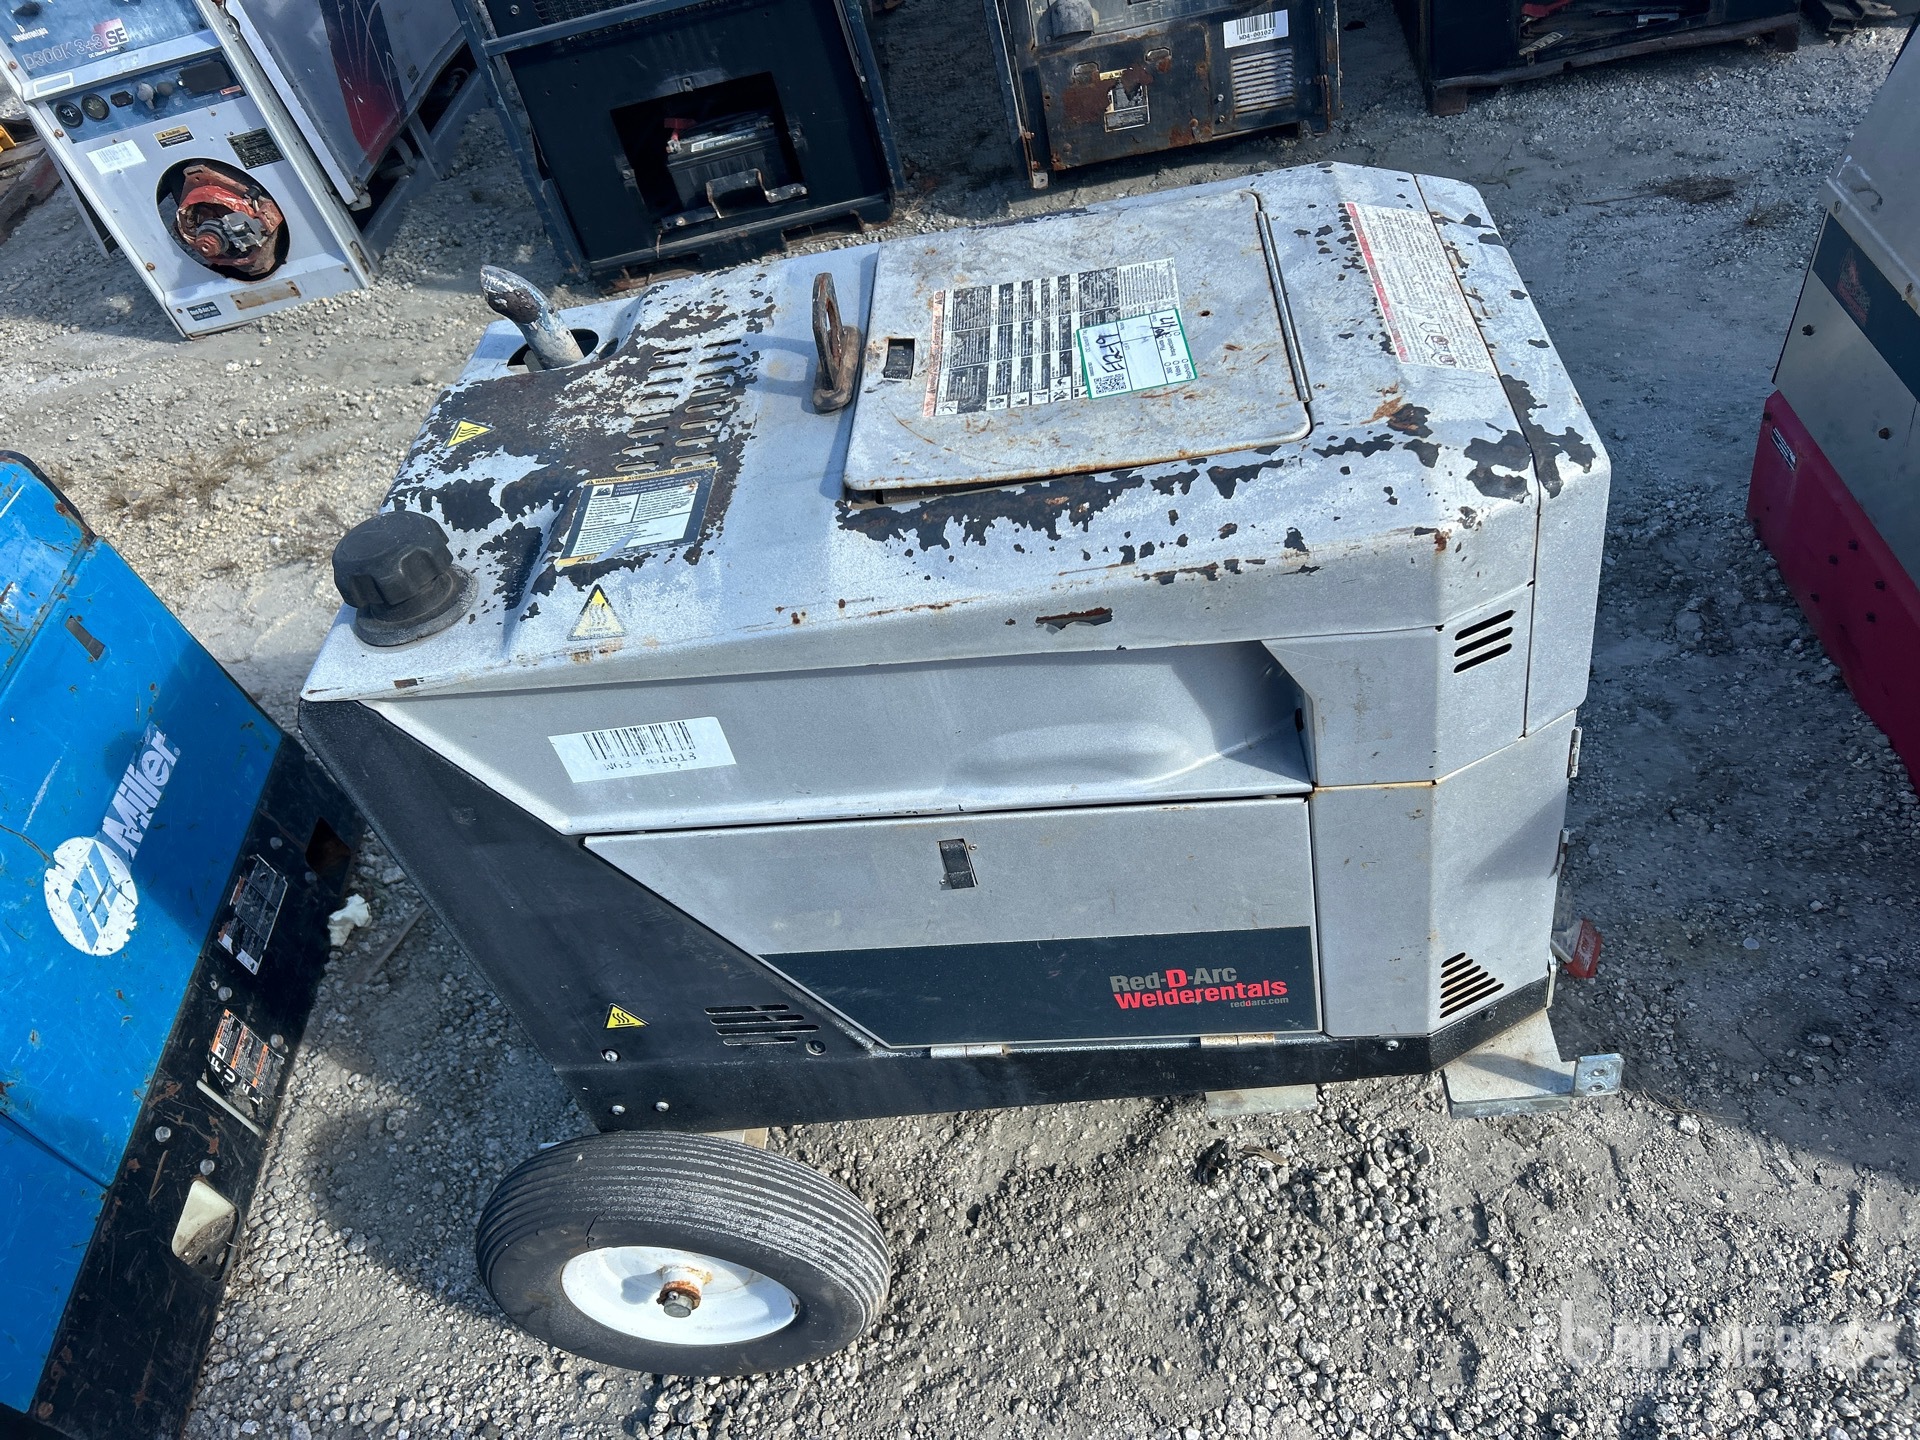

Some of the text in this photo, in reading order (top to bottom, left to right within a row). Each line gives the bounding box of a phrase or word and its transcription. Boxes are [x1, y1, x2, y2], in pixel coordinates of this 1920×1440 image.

[22, 27, 128, 70] D300K 3+3 SE
[102, 730, 177, 861] Miller
[1109, 967, 1238, 993] Red-D-Arc
[1113, 979, 1289, 1010] Welderentals
[1230, 997, 1290, 1009] reddarc.com
